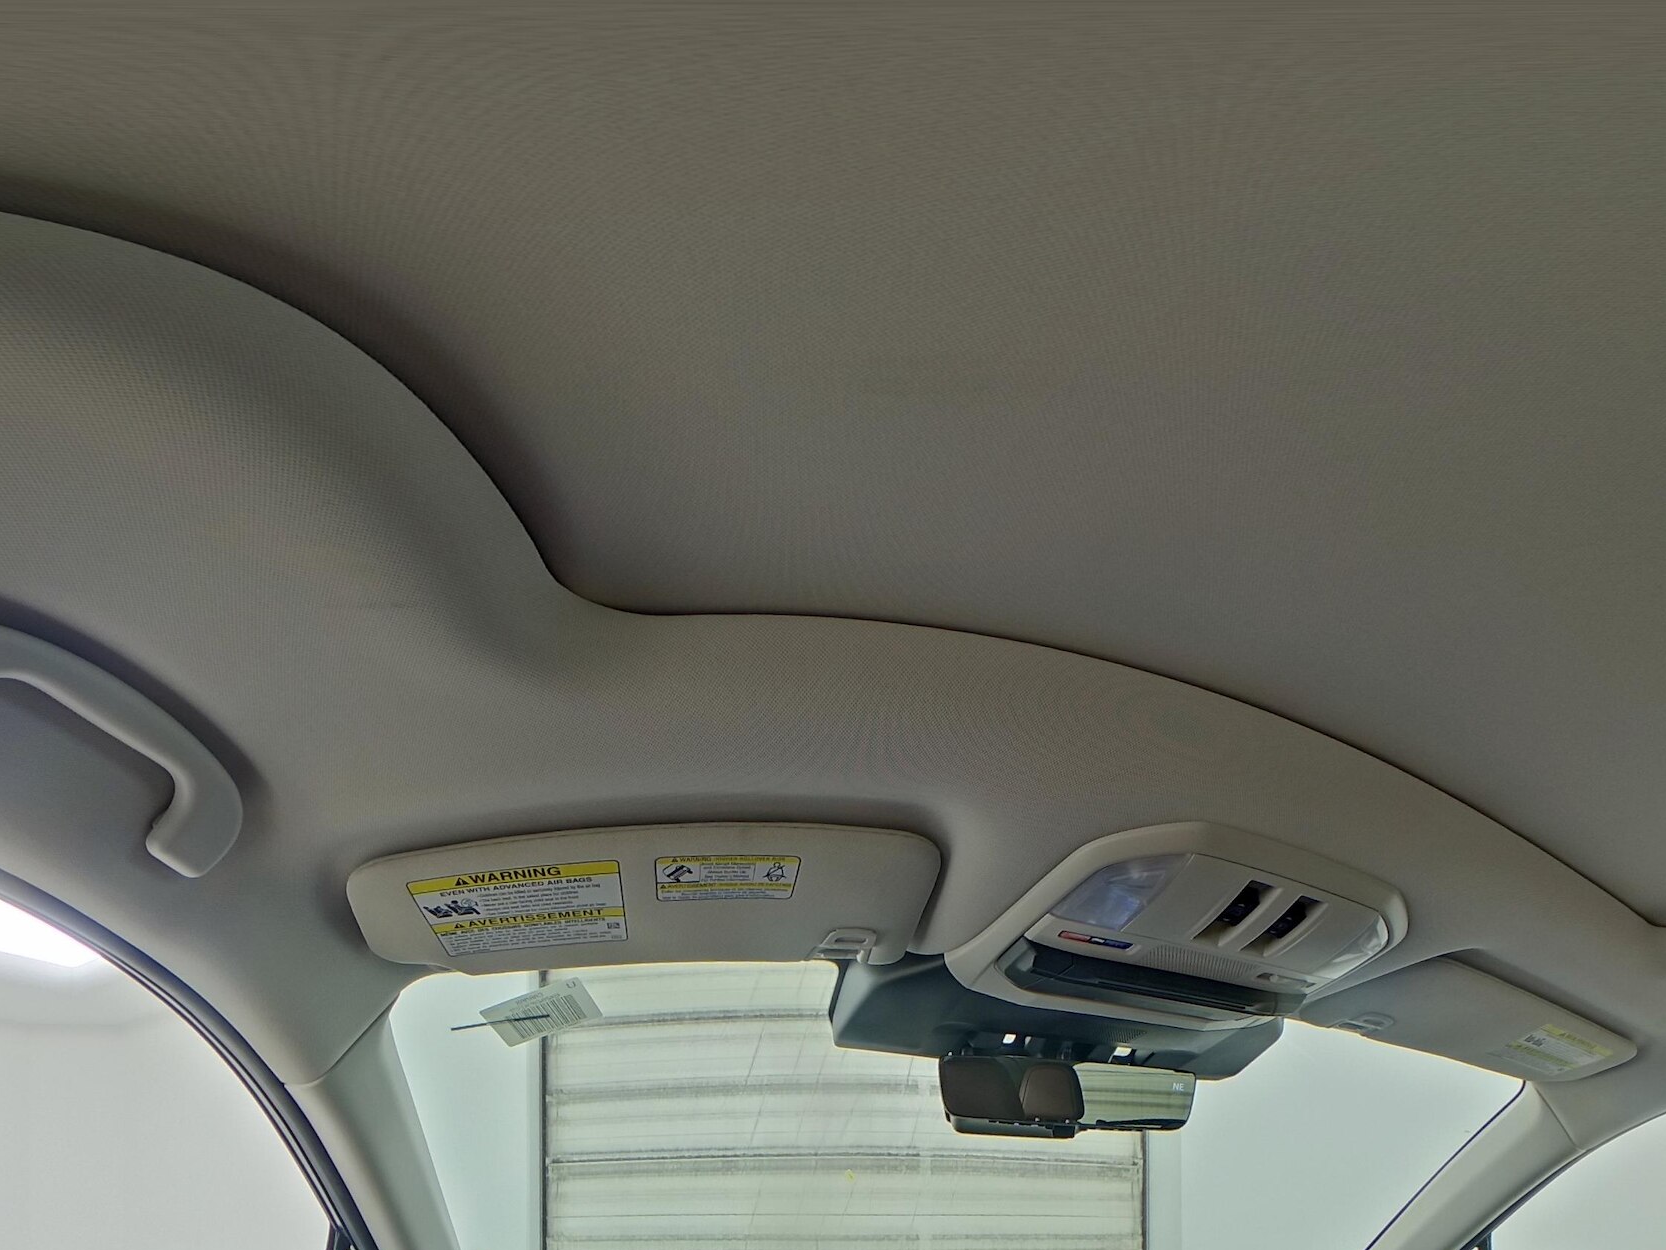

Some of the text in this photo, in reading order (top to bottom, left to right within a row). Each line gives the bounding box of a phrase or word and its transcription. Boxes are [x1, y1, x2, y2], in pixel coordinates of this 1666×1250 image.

[469, 866, 561, 885] WARNING
[440, 888, 466, 898] EVEN
[465, 885, 491, 894] WITH
[493, 880, 545, 891] ADVANCED
[546, 878, 564, 886] AIR
[469, 909, 603, 927] AVERTISSEMENT
[1172, 1082, 1185, 1091] NE
